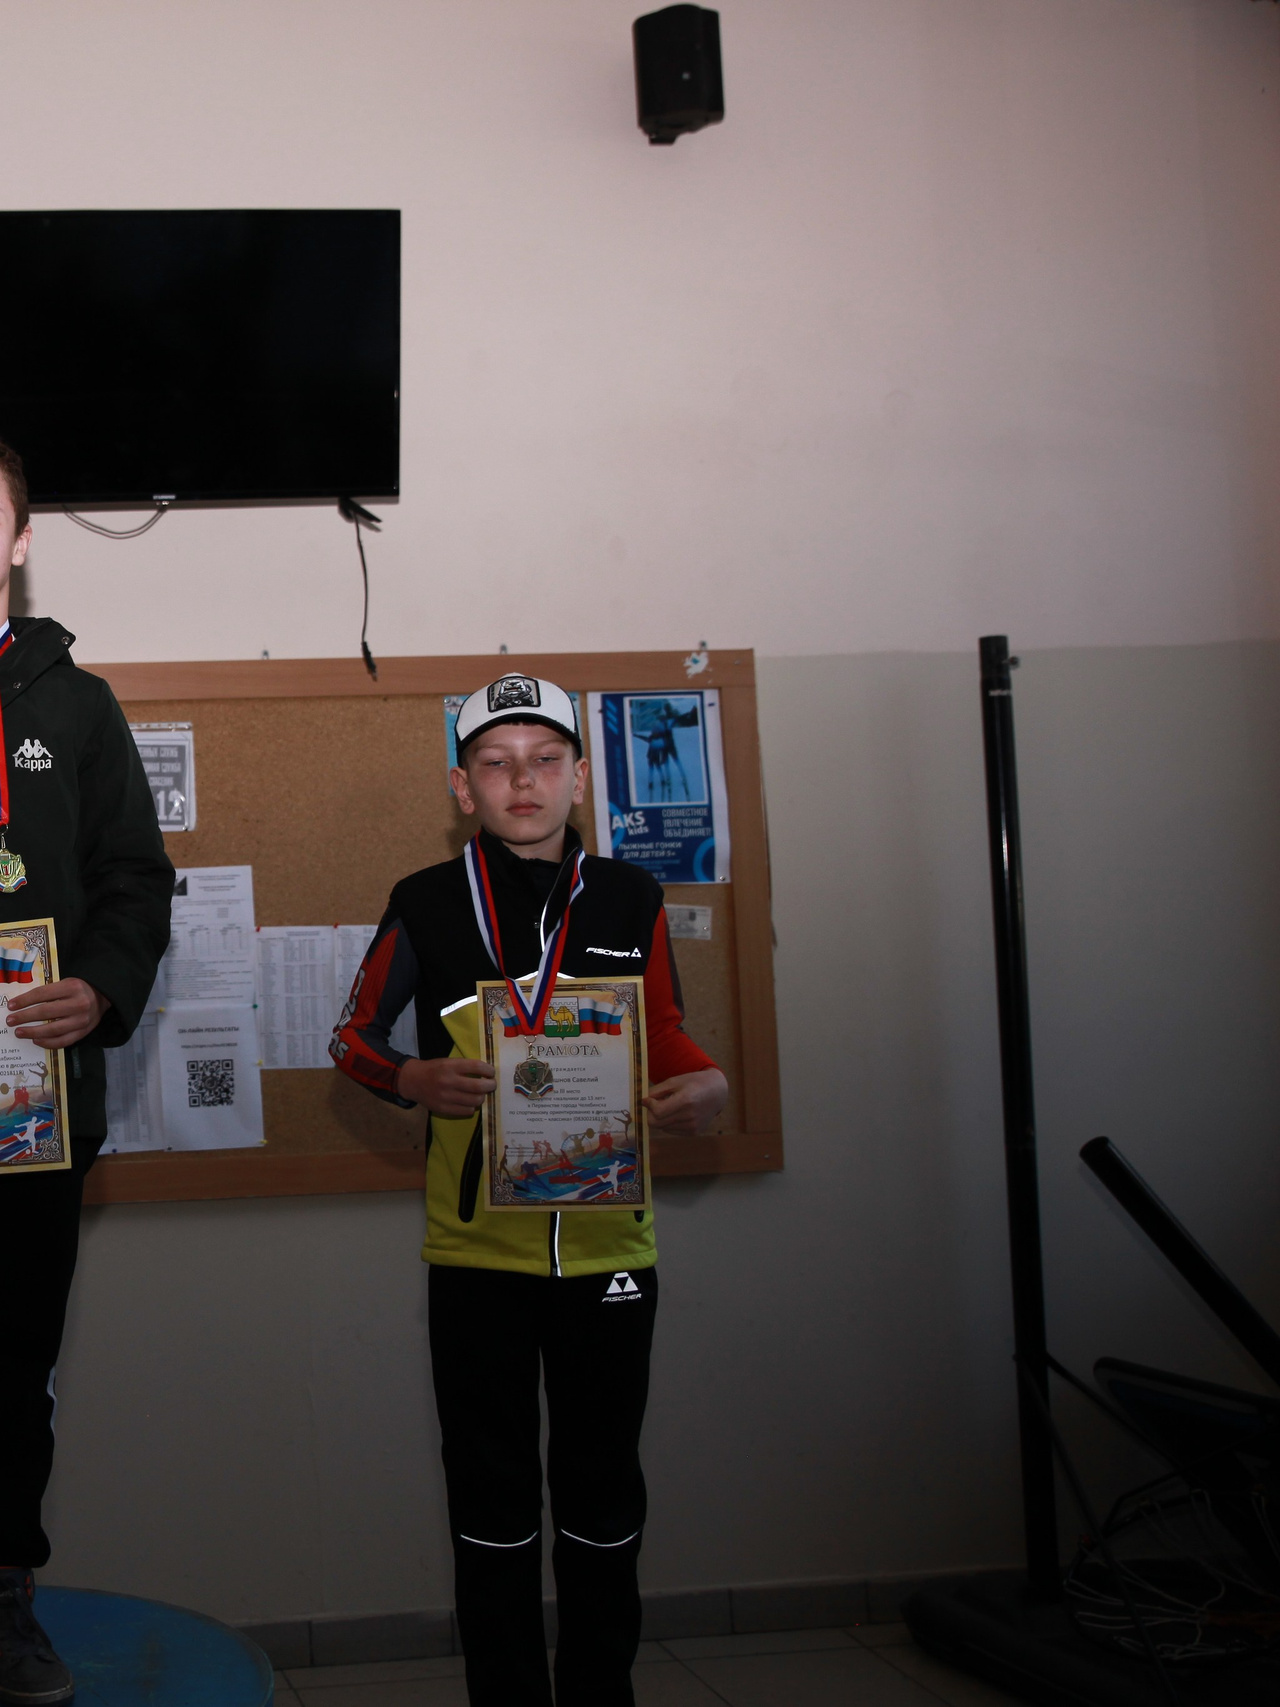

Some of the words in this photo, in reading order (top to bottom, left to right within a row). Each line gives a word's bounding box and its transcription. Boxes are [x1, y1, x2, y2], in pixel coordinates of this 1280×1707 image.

[14, 757, 52, 771] Kappa
[157, 789, 184, 821] 12
[662, 808, 708, 817] СОВМЕСТНОЕ
[612, 811, 645, 830] AKS
[663, 817, 703, 827] УВЛЕЧЕНИЕ
[628, 826, 649, 836] kids
[640, 850, 665, 858] ДЕТЕЙ
[586, 947, 630, 957] FISCHER
[601, 1293, 642, 1302] FISCHER
